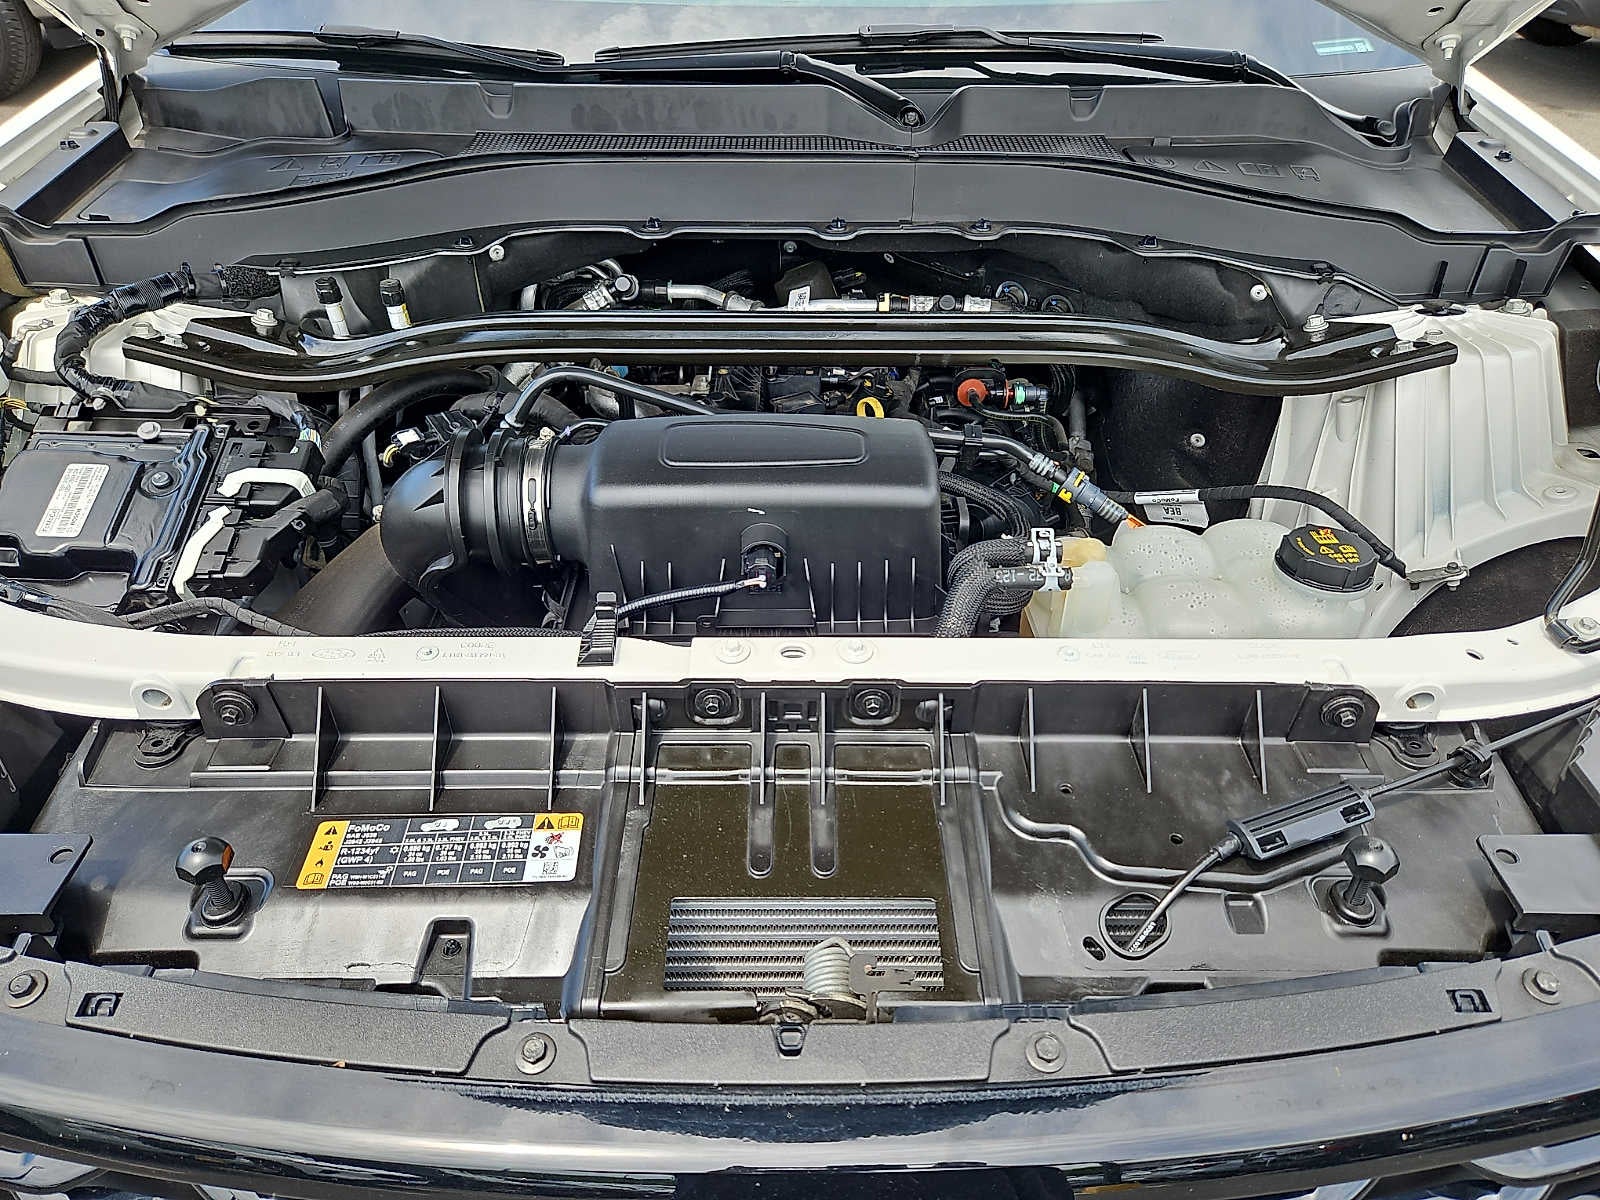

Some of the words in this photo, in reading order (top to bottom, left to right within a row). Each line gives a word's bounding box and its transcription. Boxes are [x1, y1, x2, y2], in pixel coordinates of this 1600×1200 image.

[1163, 506, 1182, 515] BEA
[348, 823, 391, 832] FoMoCo
[340, 847, 380, 856] R-1234yf
[337, 856, 363, 865] (GWP
[364, 856, 374, 864] 4)
